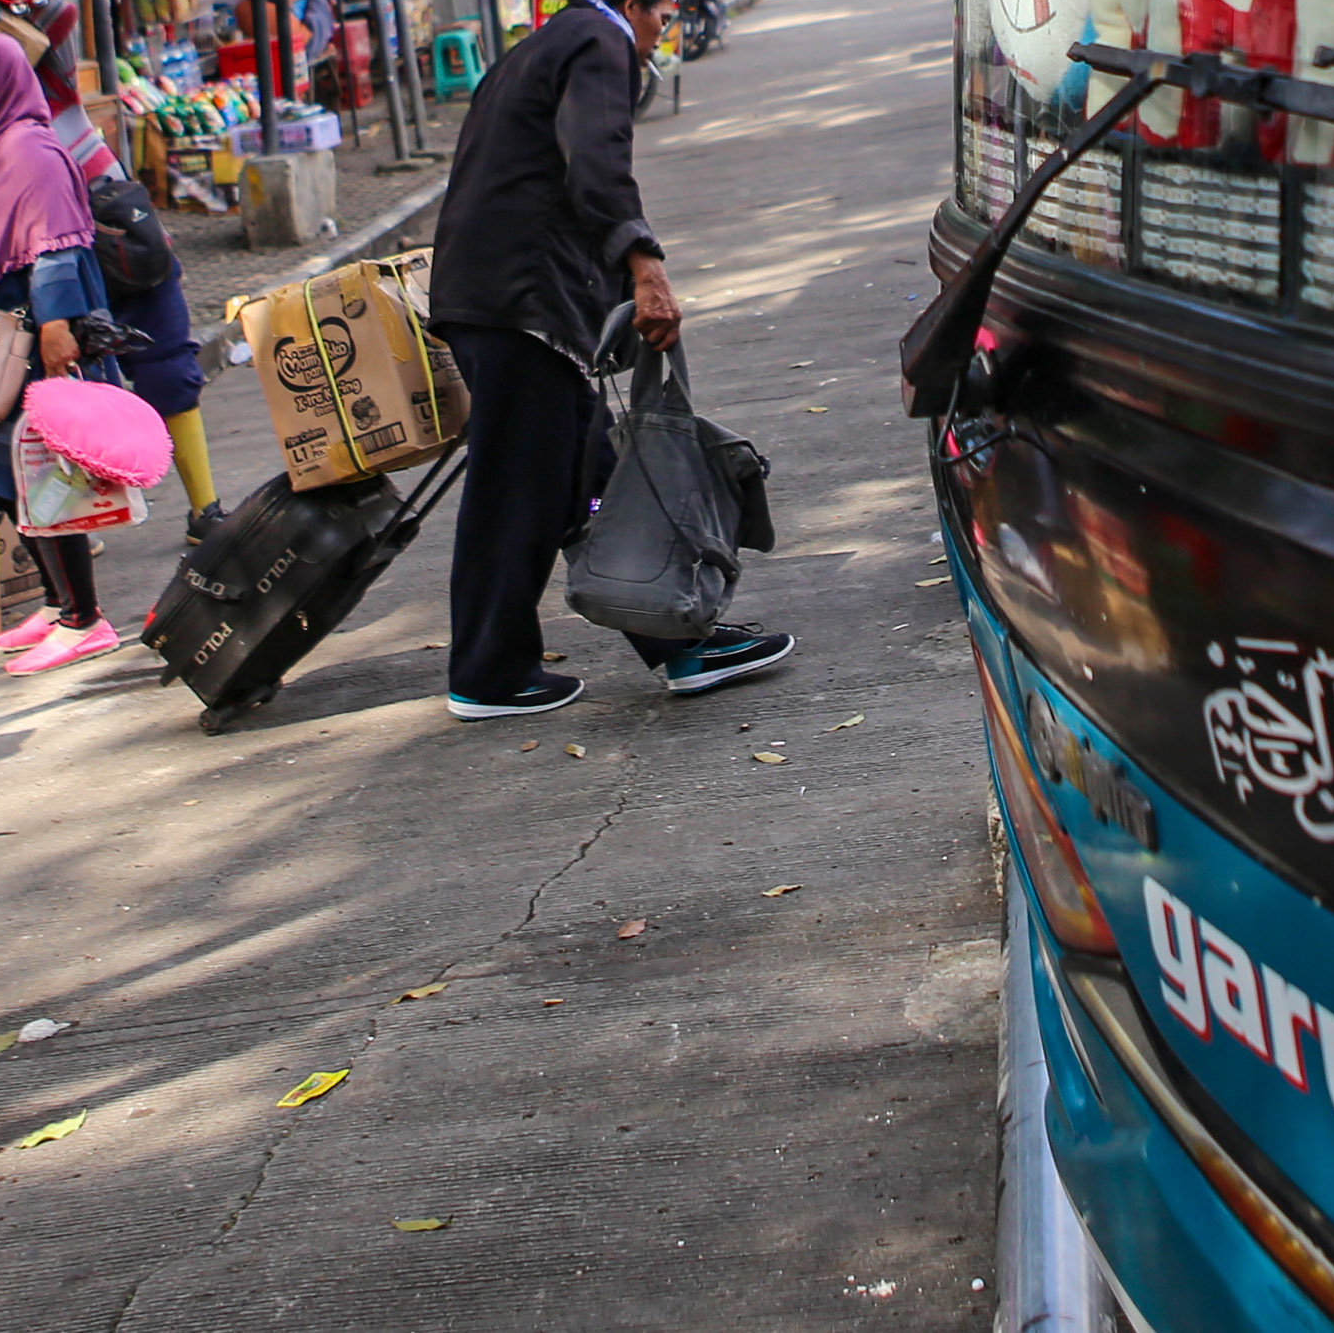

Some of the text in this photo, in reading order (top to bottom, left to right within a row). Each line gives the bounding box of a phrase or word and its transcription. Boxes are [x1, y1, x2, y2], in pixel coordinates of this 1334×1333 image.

[184, 567, 226, 596] POLO
[256, 548, 299, 594] POLO
[193, 621, 235, 666] POLO
